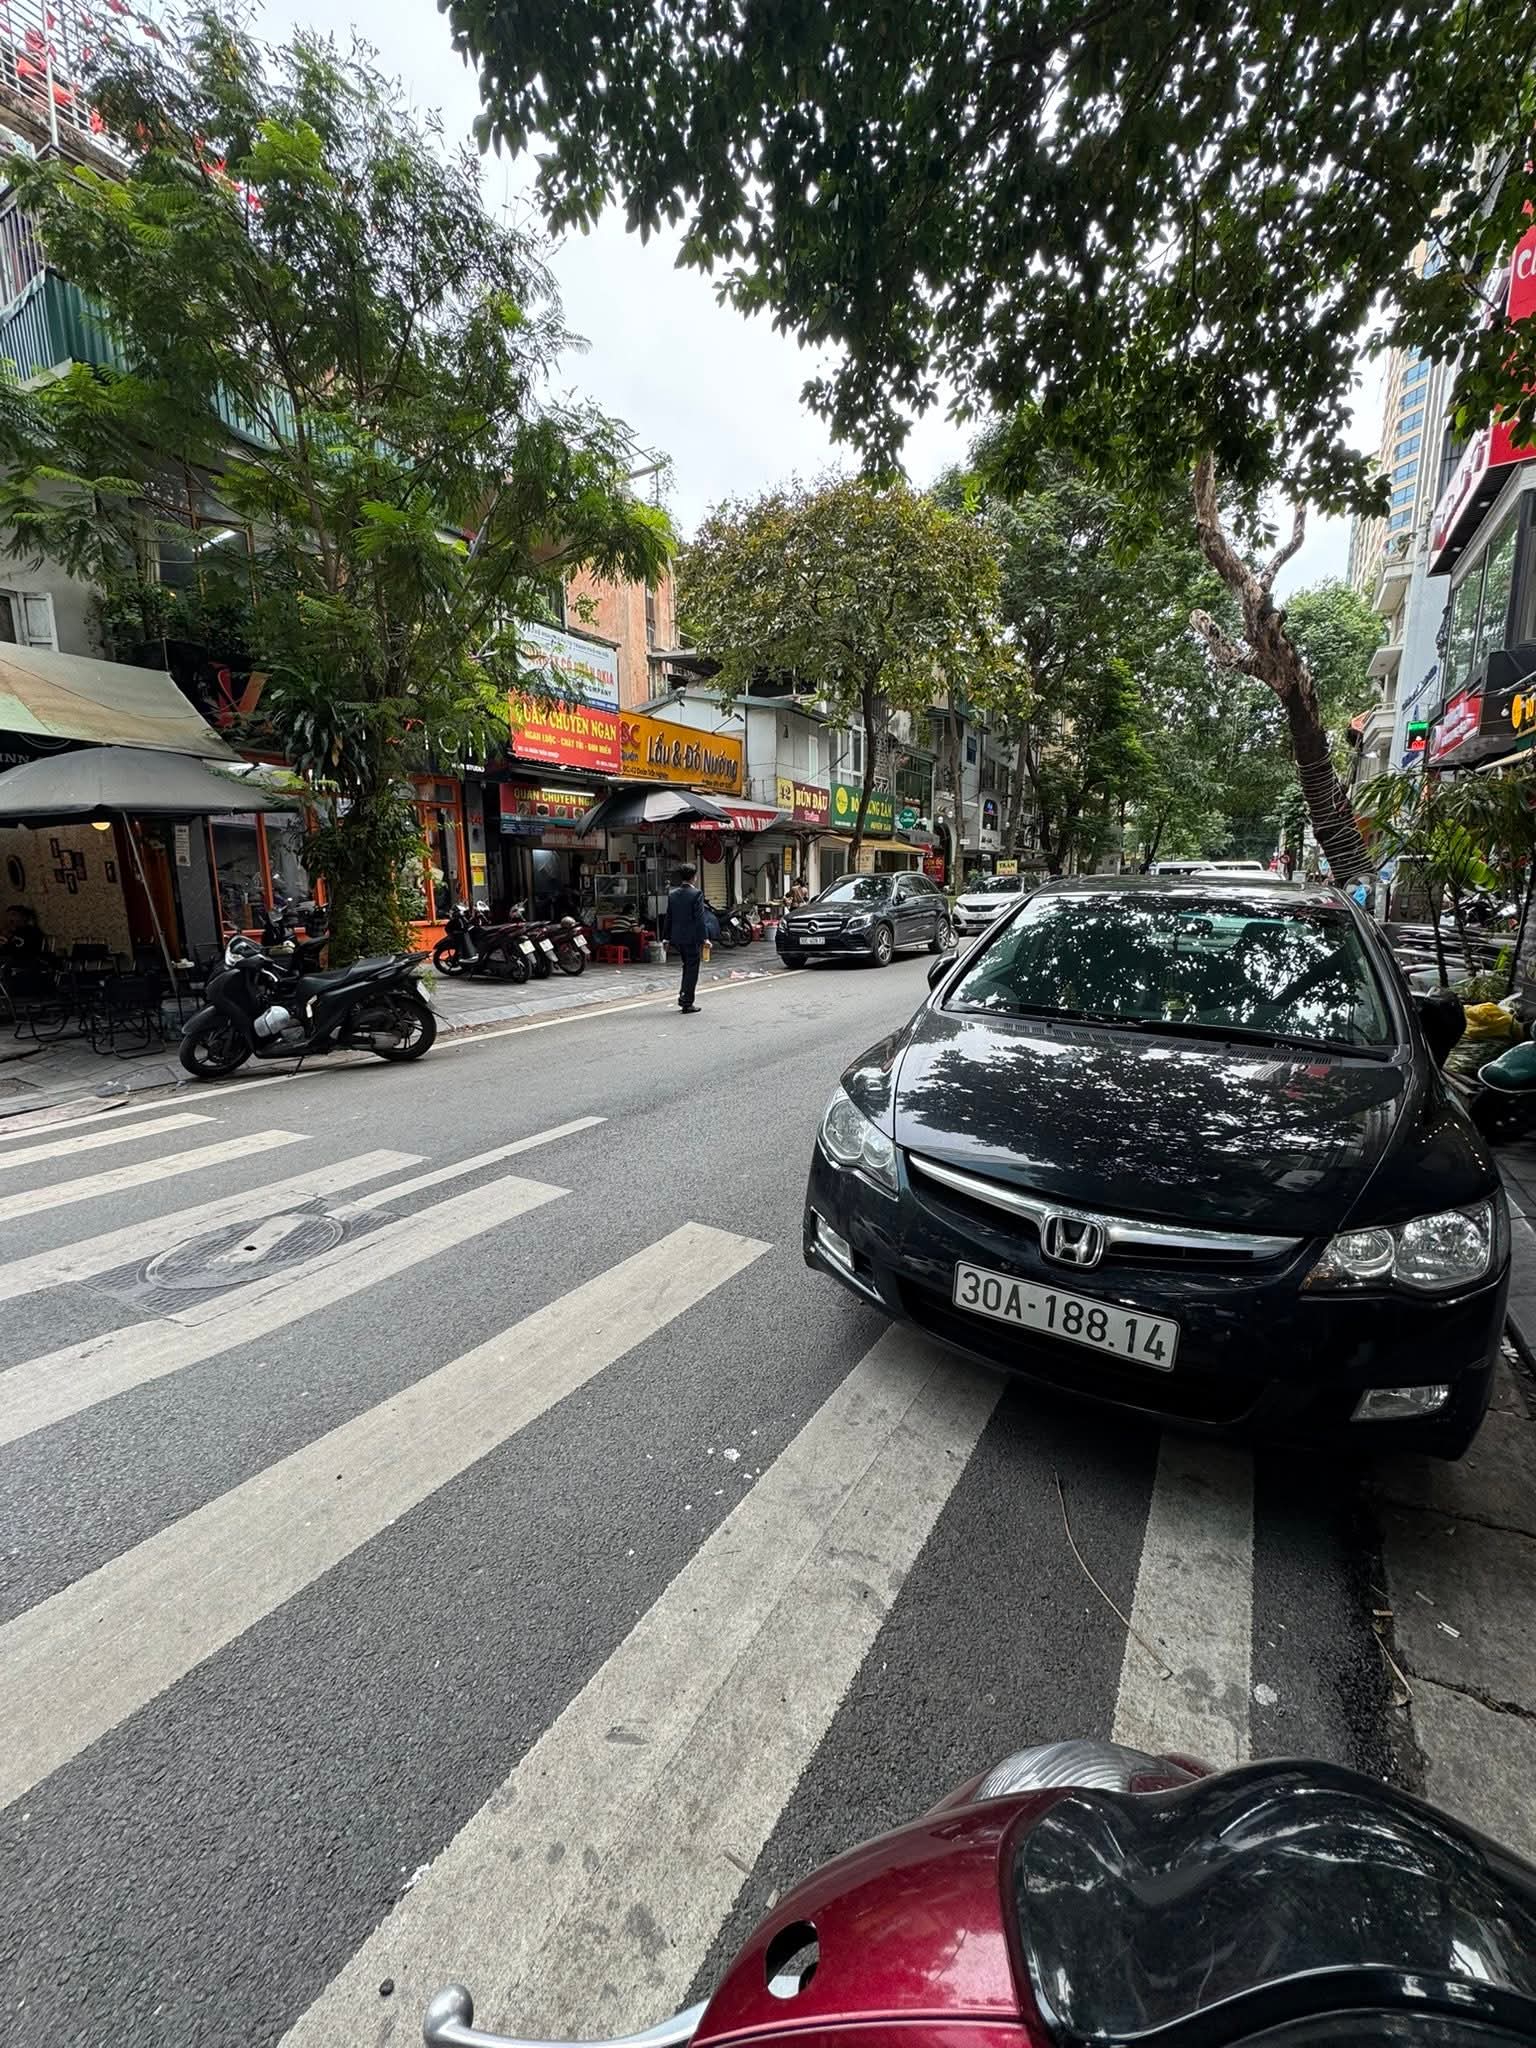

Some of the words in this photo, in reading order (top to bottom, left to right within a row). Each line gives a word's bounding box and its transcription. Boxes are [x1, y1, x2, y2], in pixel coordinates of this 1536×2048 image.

[585, 685, 612, 697] COMPANY
[590, 719, 617, 742] NGAN
[672, 740, 682, 769] &
[702, 748, 738, 783] Nướng
[795, 786, 811, 808] BÚN
[812, 790, 828, 814] ĐẬU
[961, 1271, 1166, 1362] 30A-188.14
